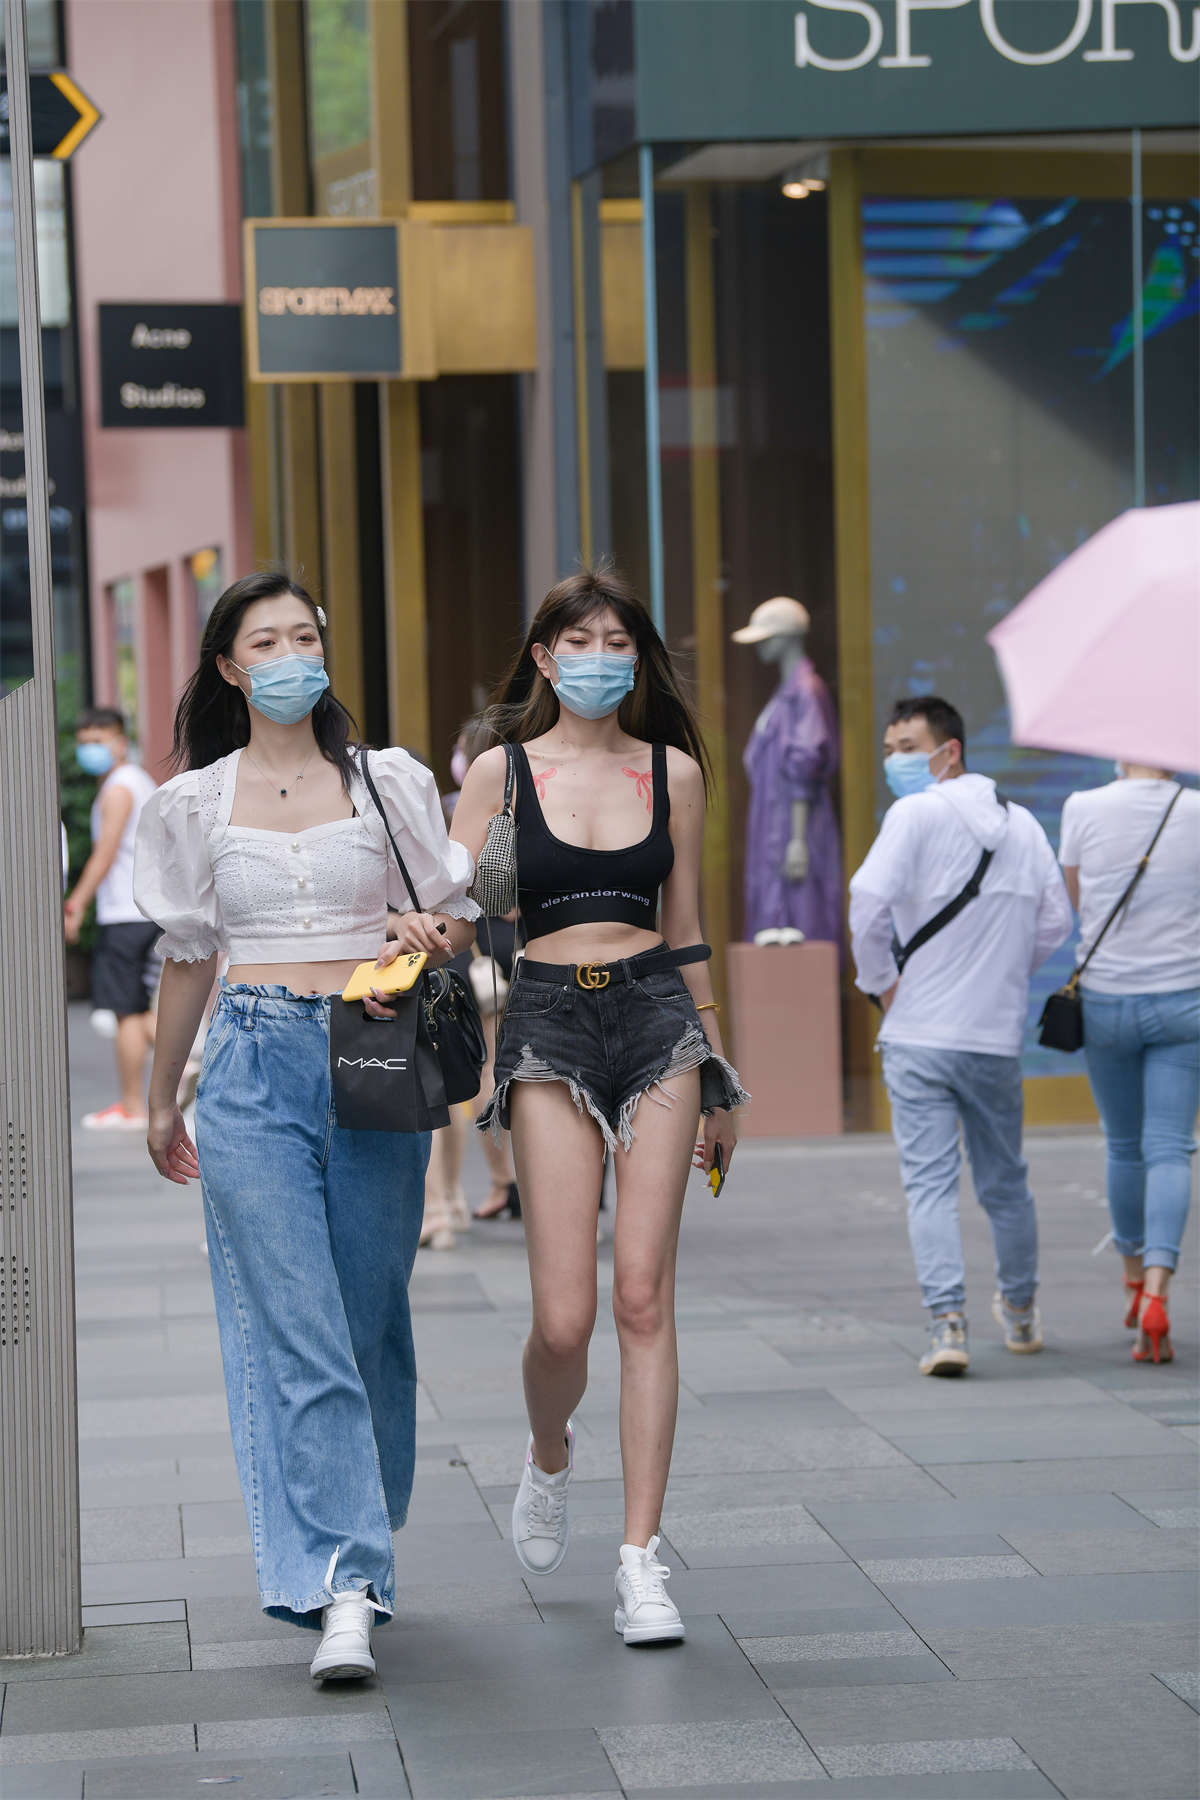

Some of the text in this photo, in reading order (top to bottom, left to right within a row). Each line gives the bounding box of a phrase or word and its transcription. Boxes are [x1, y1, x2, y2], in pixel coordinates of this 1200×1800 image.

[131, 322, 191, 350] Acne
[120, 382, 206, 409] Studios
[541, 889, 651, 909] alexanderwang
